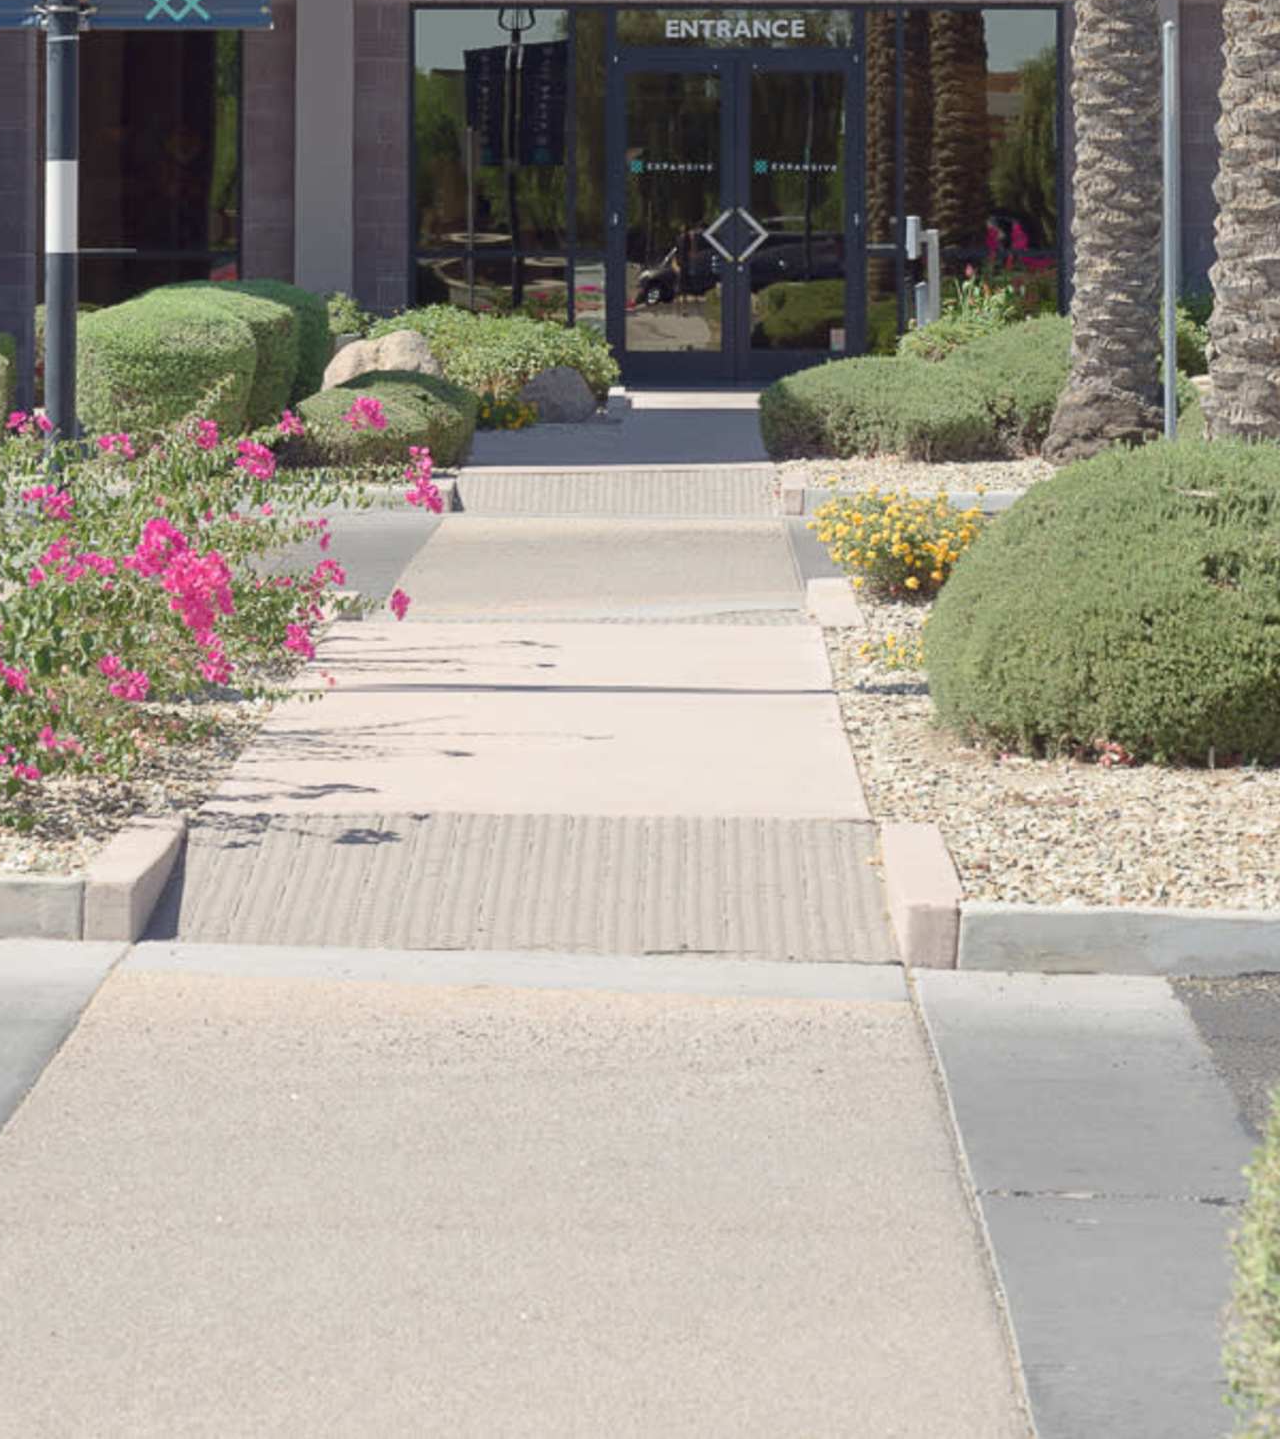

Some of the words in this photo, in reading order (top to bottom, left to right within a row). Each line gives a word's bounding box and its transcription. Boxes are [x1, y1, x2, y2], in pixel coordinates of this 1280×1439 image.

[664, 18, 806, 39] ENTRANCE
[646, 162, 714, 172] EXPANSIVE
[770, 162, 838, 173] EXPANSIVE
